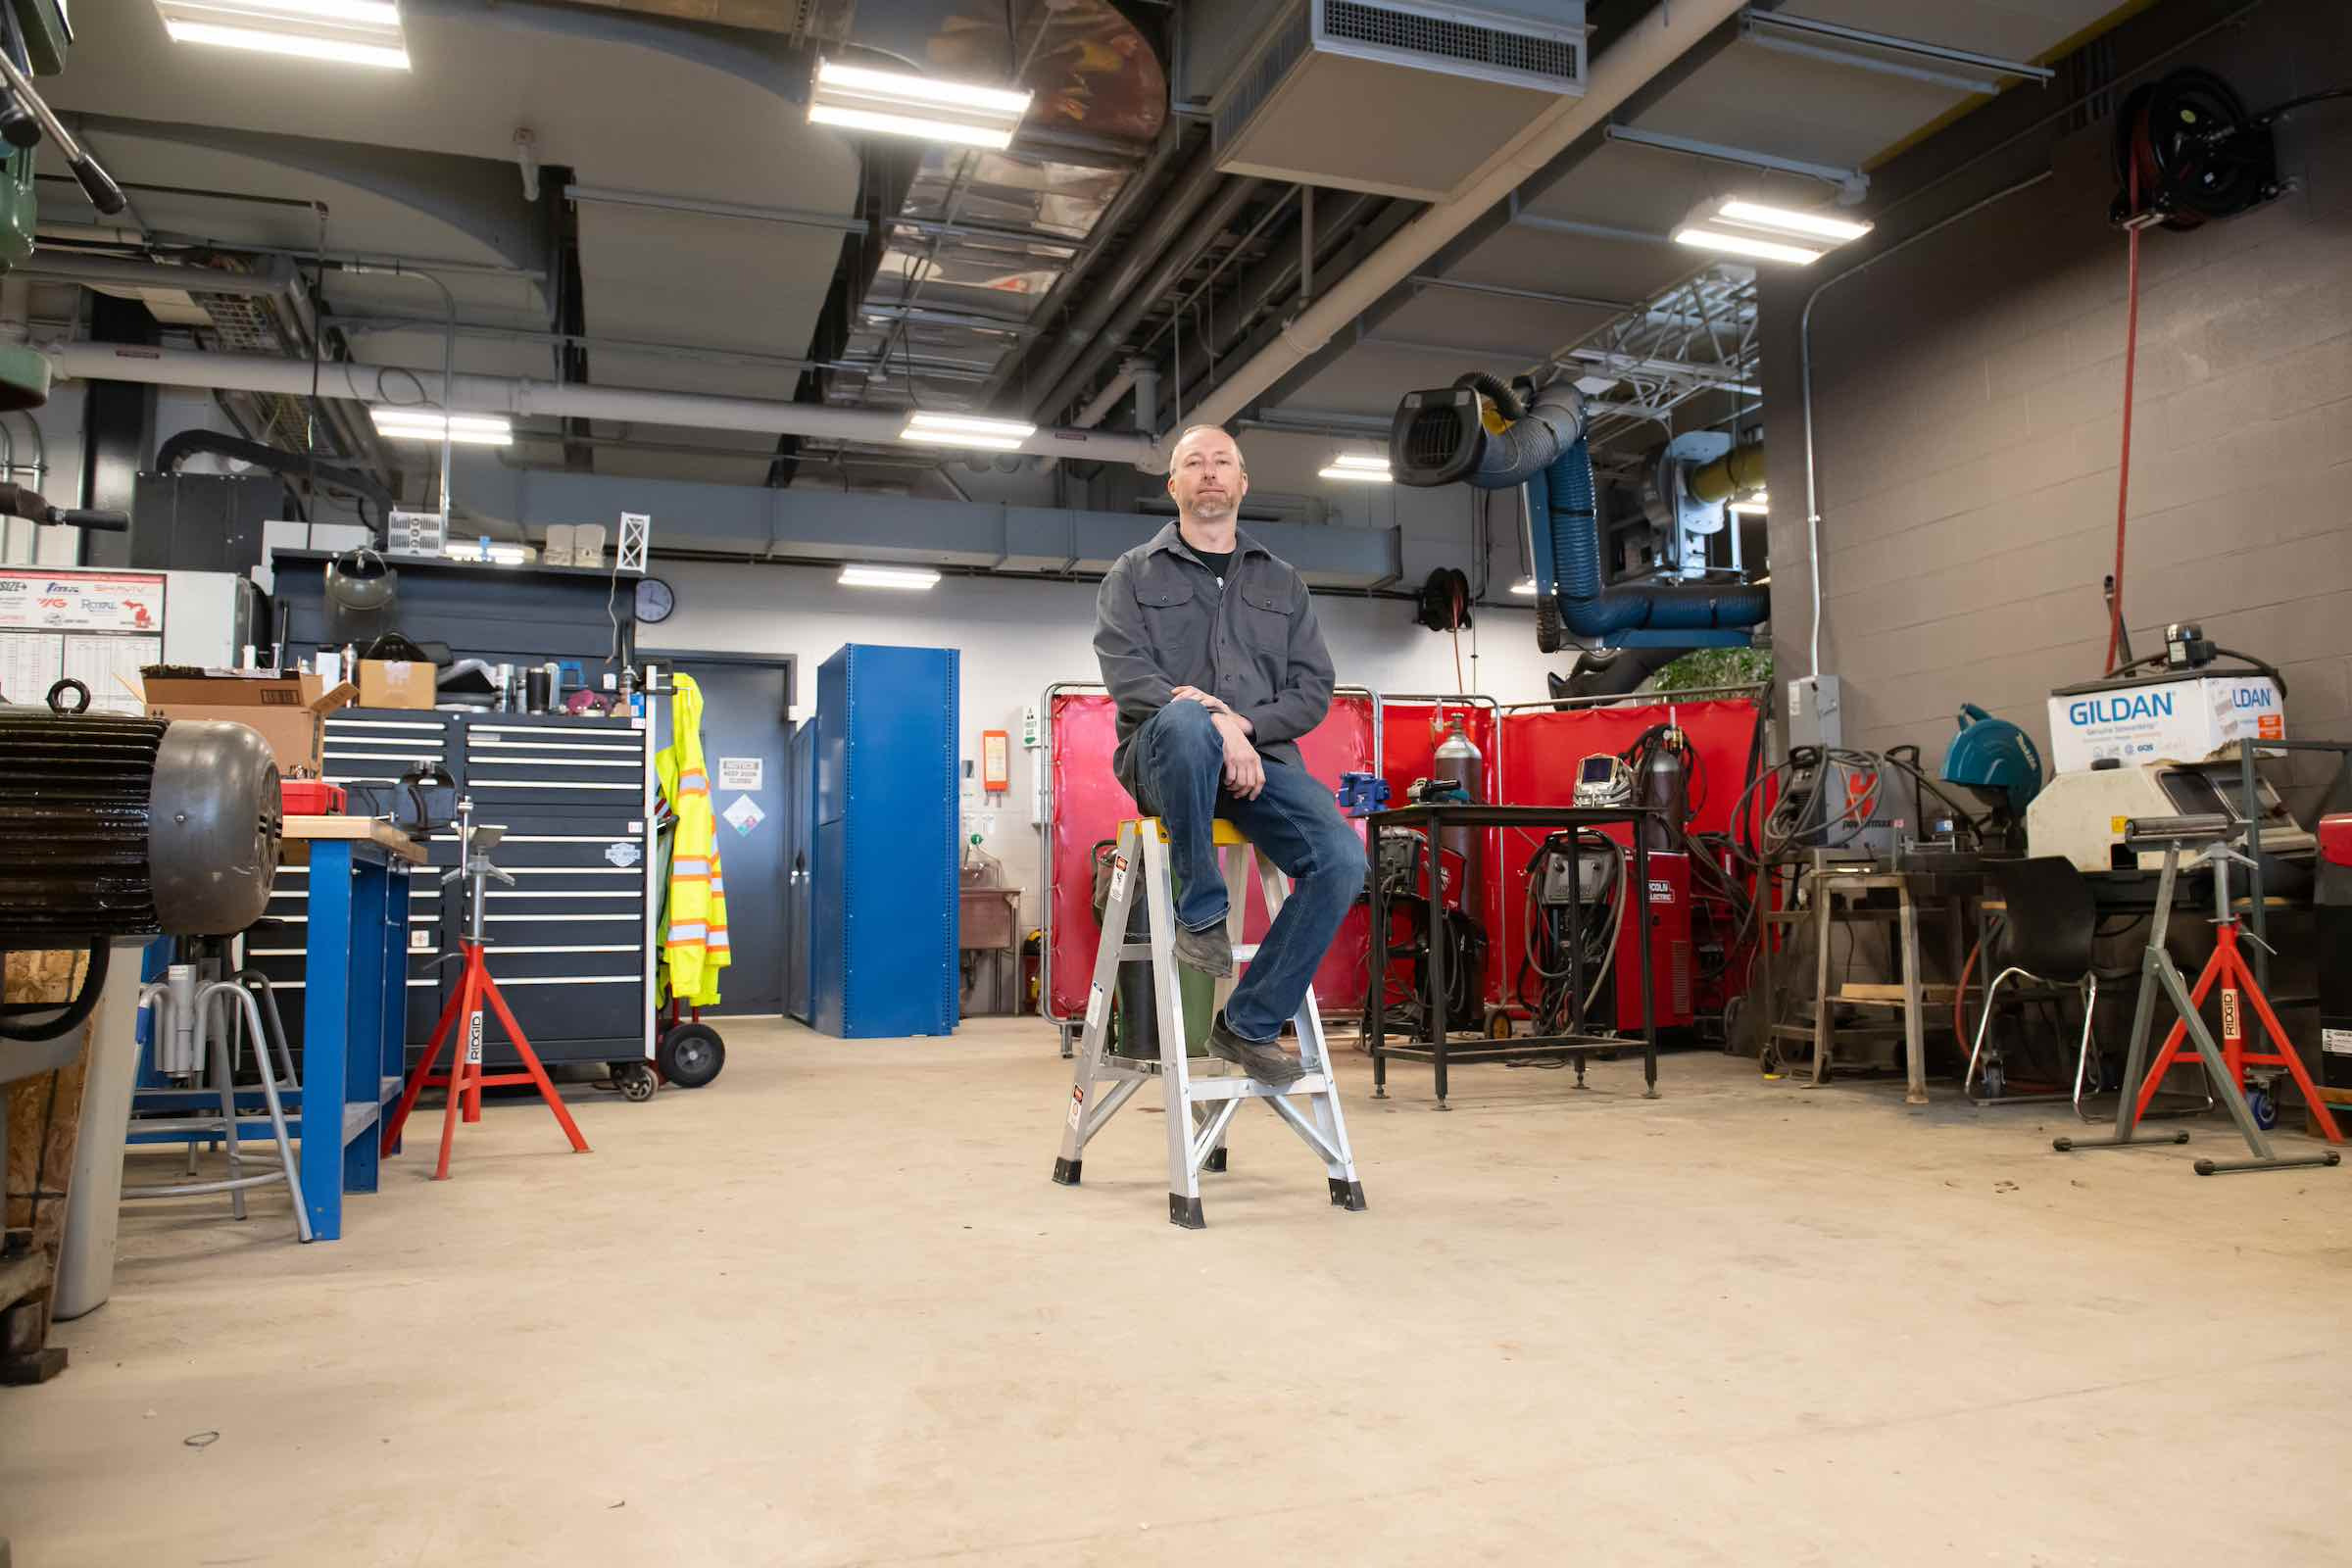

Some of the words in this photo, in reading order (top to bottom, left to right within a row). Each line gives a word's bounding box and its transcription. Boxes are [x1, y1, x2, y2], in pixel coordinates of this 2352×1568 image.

[2070, 692, 2173, 726] GILDAN
[2232, 688, 2272, 708] LDAN
[2225, 994, 2235, 1036] RIDGID
[470, 1015, 481, 1060] RIDGID
